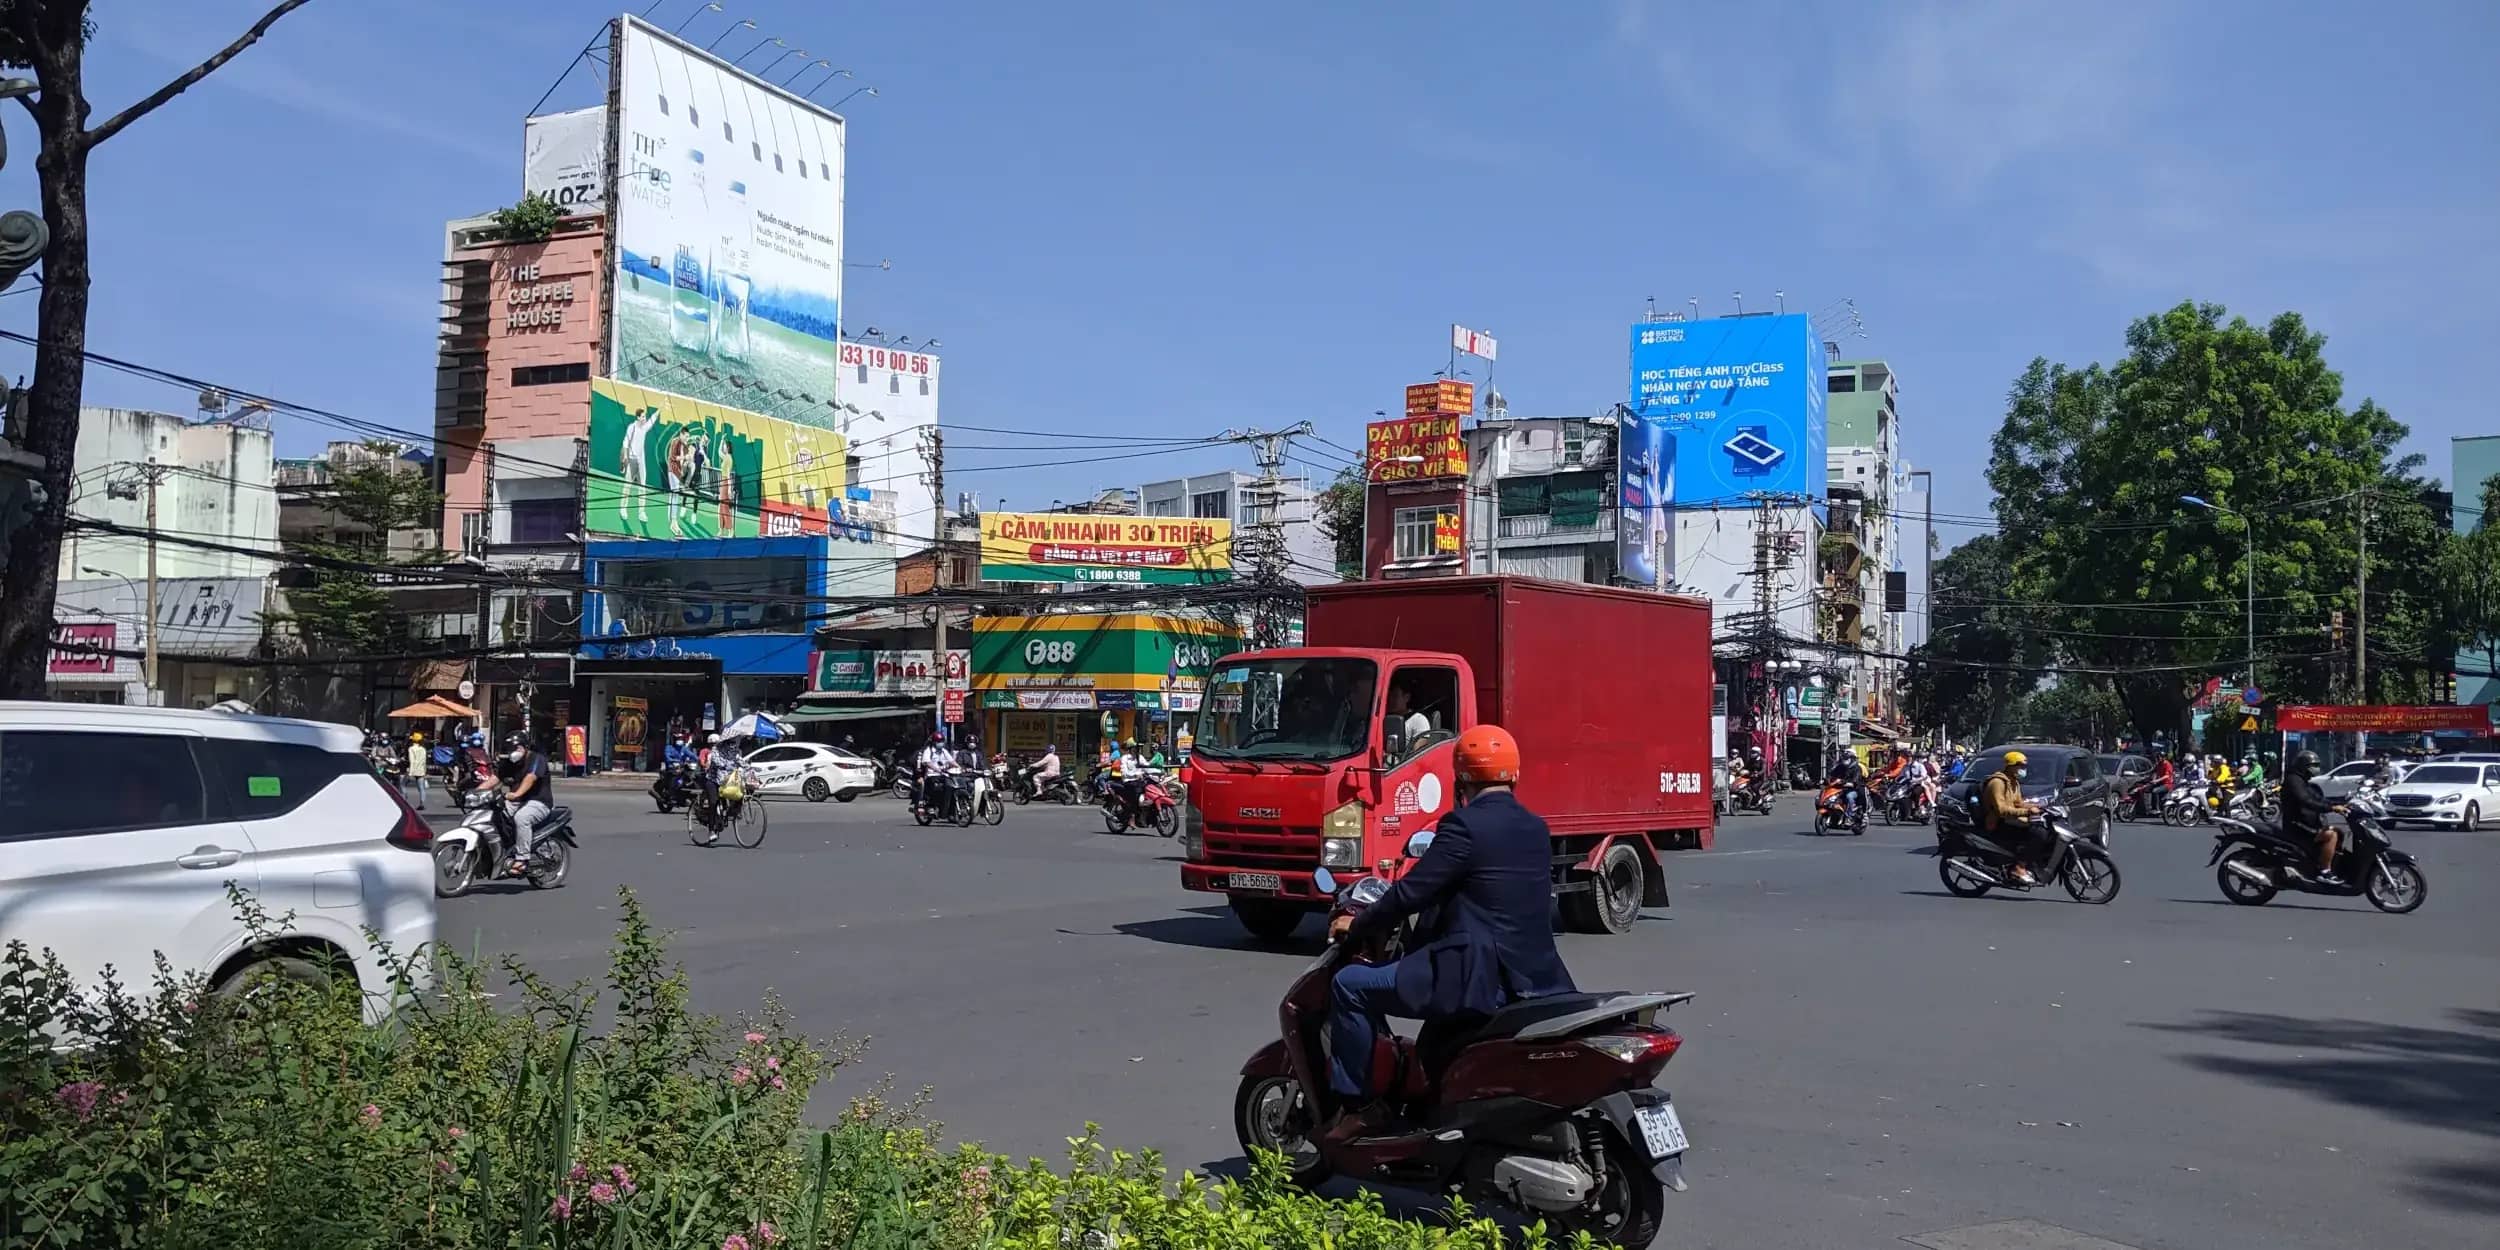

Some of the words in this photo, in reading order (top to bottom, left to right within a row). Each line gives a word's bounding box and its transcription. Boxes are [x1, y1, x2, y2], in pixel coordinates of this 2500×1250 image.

[632, 131, 655, 157] TH
[630, 181, 672, 210] WATER
[510, 264, 540, 282] THE
[508, 282, 573, 305] COFFEE
[507, 308, 561, 328] HOUSE
[868, 348, 885, 368] 19
[889, 352, 907, 372] 00
[911, 355, 929, 375] 56
[1641, 369, 1666, 381] HỌC
[1668, 364, 1702, 379] TIẾNG
[1705, 366, 1729, 376] ANH
[1732, 362, 1784, 377] myClass
[1676, 379, 1707, 391] NGAY
[1710, 377, 1734, 389] QUÀ
[1695, 410, 1716, 420] 1299
[1409, 417, 1457, 438] THÊM
[1001, 514, 1045, 540] CẦM
[1053, 521, 1121, 541] NHANH
[1128, 524, 1153, 541] 30
[1157, 521, 1213, 543] TRIỆU
[1126, 551, 1143, 563] XE
[1145, 547, 1173, 564] MÁY
[1089, 571, 1114, 580] 1800
[1116, 571, 1141, 581] 6388
[1025, 639, 1077, 665] F88
[759, 771, 804, 788] port
[1239, 807, 1281, 818] ISUZU
[1647, 1127, 1685, 1154] 854.05
